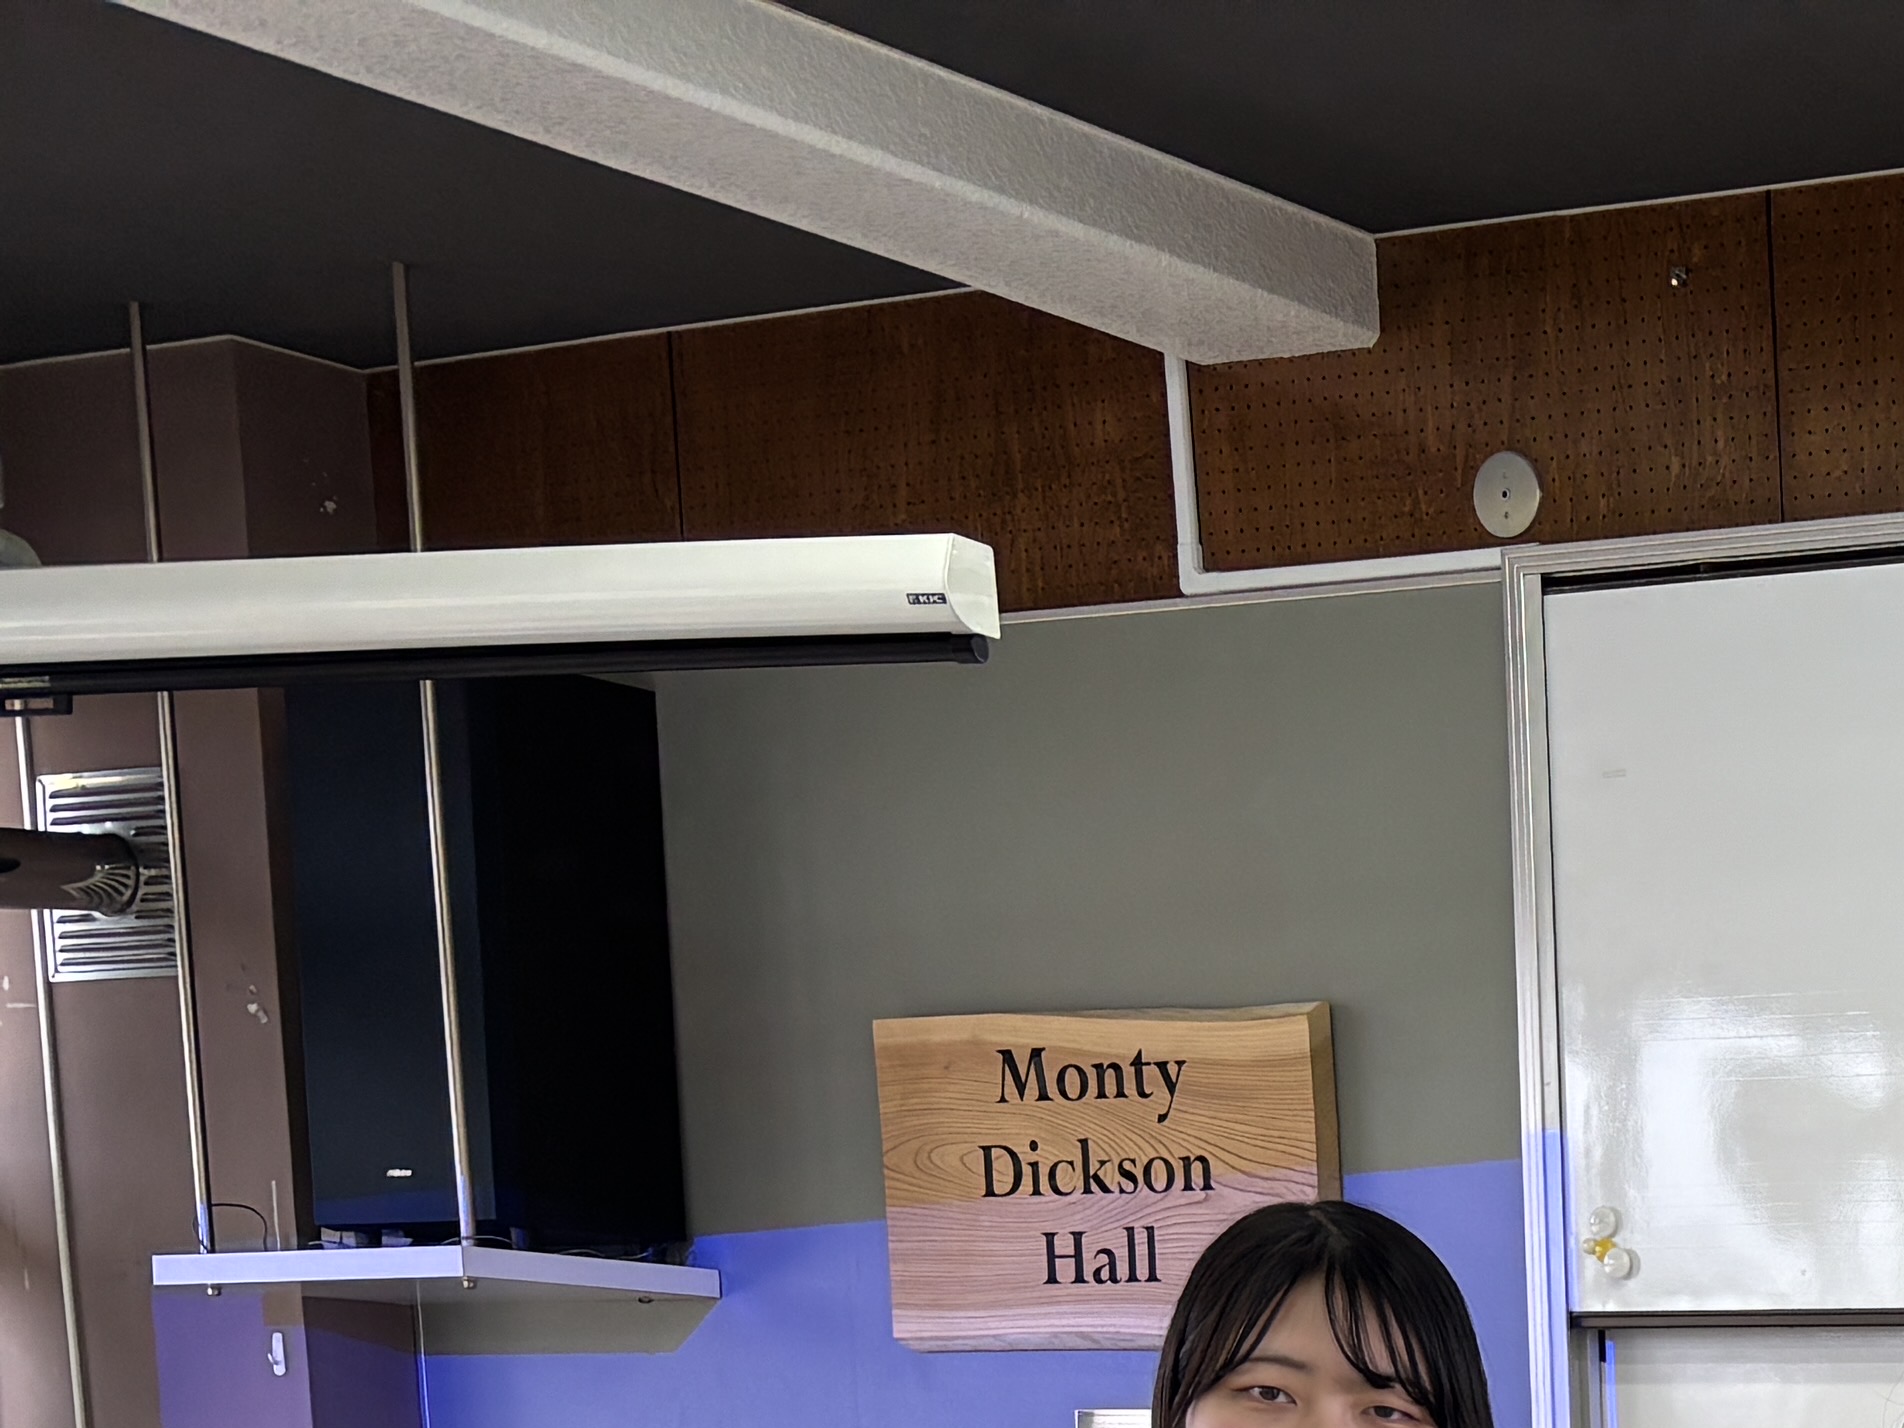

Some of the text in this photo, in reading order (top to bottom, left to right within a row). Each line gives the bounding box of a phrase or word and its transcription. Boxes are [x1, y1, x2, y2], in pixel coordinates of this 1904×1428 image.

[995, 1047, 1187, 1124] Monty
[978, 1138, 1217, 1198] Dickson
[1040, 1225, 1162, 1285] Hall
